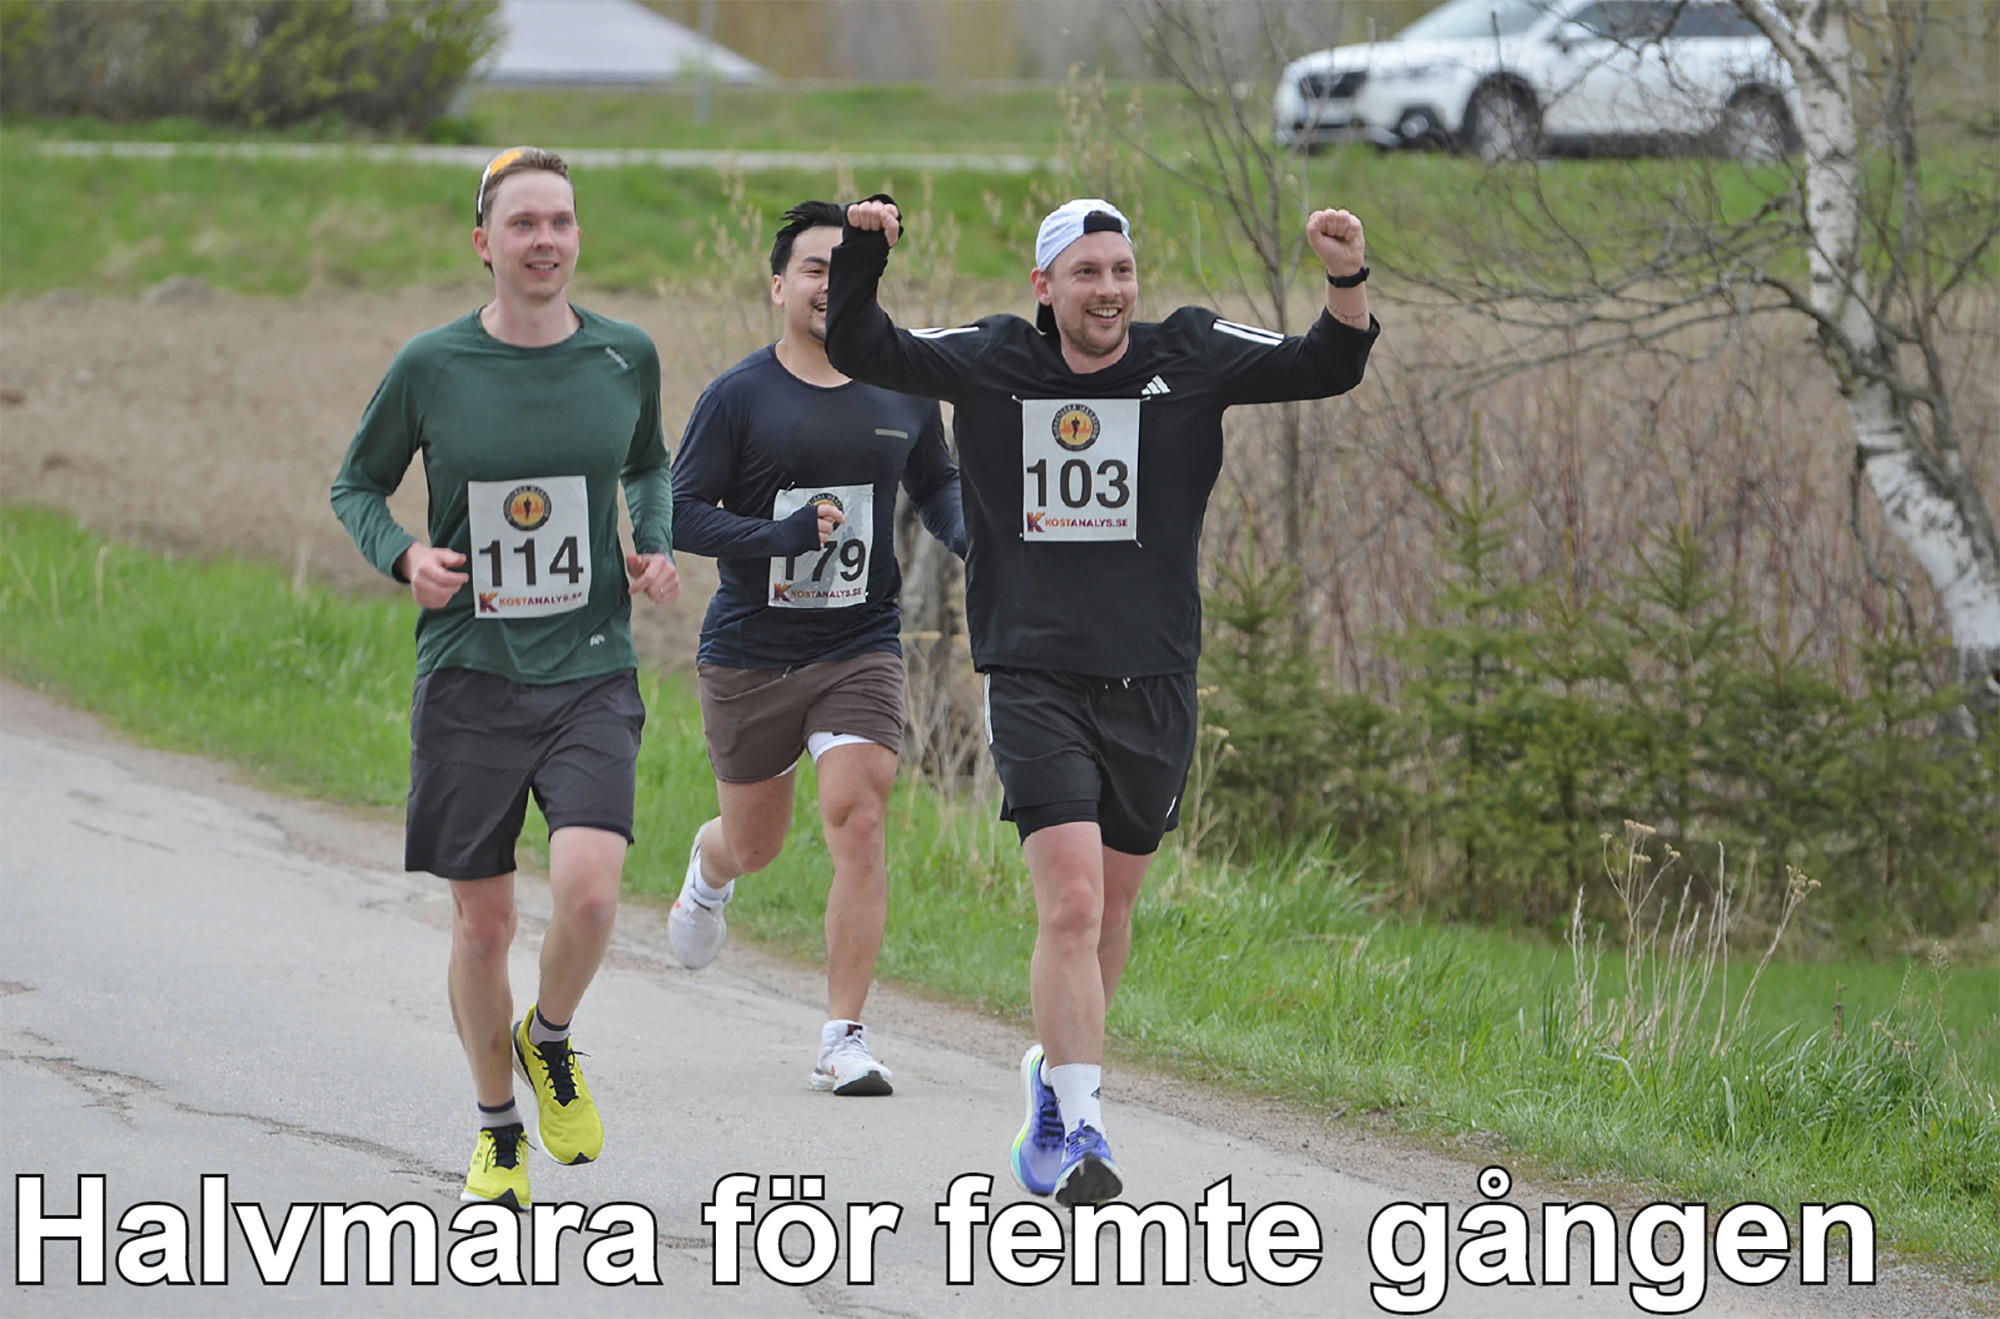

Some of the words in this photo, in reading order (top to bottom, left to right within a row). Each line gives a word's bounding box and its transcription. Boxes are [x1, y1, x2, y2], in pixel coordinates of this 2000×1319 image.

[1027, 459, 1130, 508] 103
[1045, 518, 1128, 528] KOSTANALYS.SE
[479, 536, 584, 587] 114
[791, 588, 862, 599] KOSTANALYS.SE
